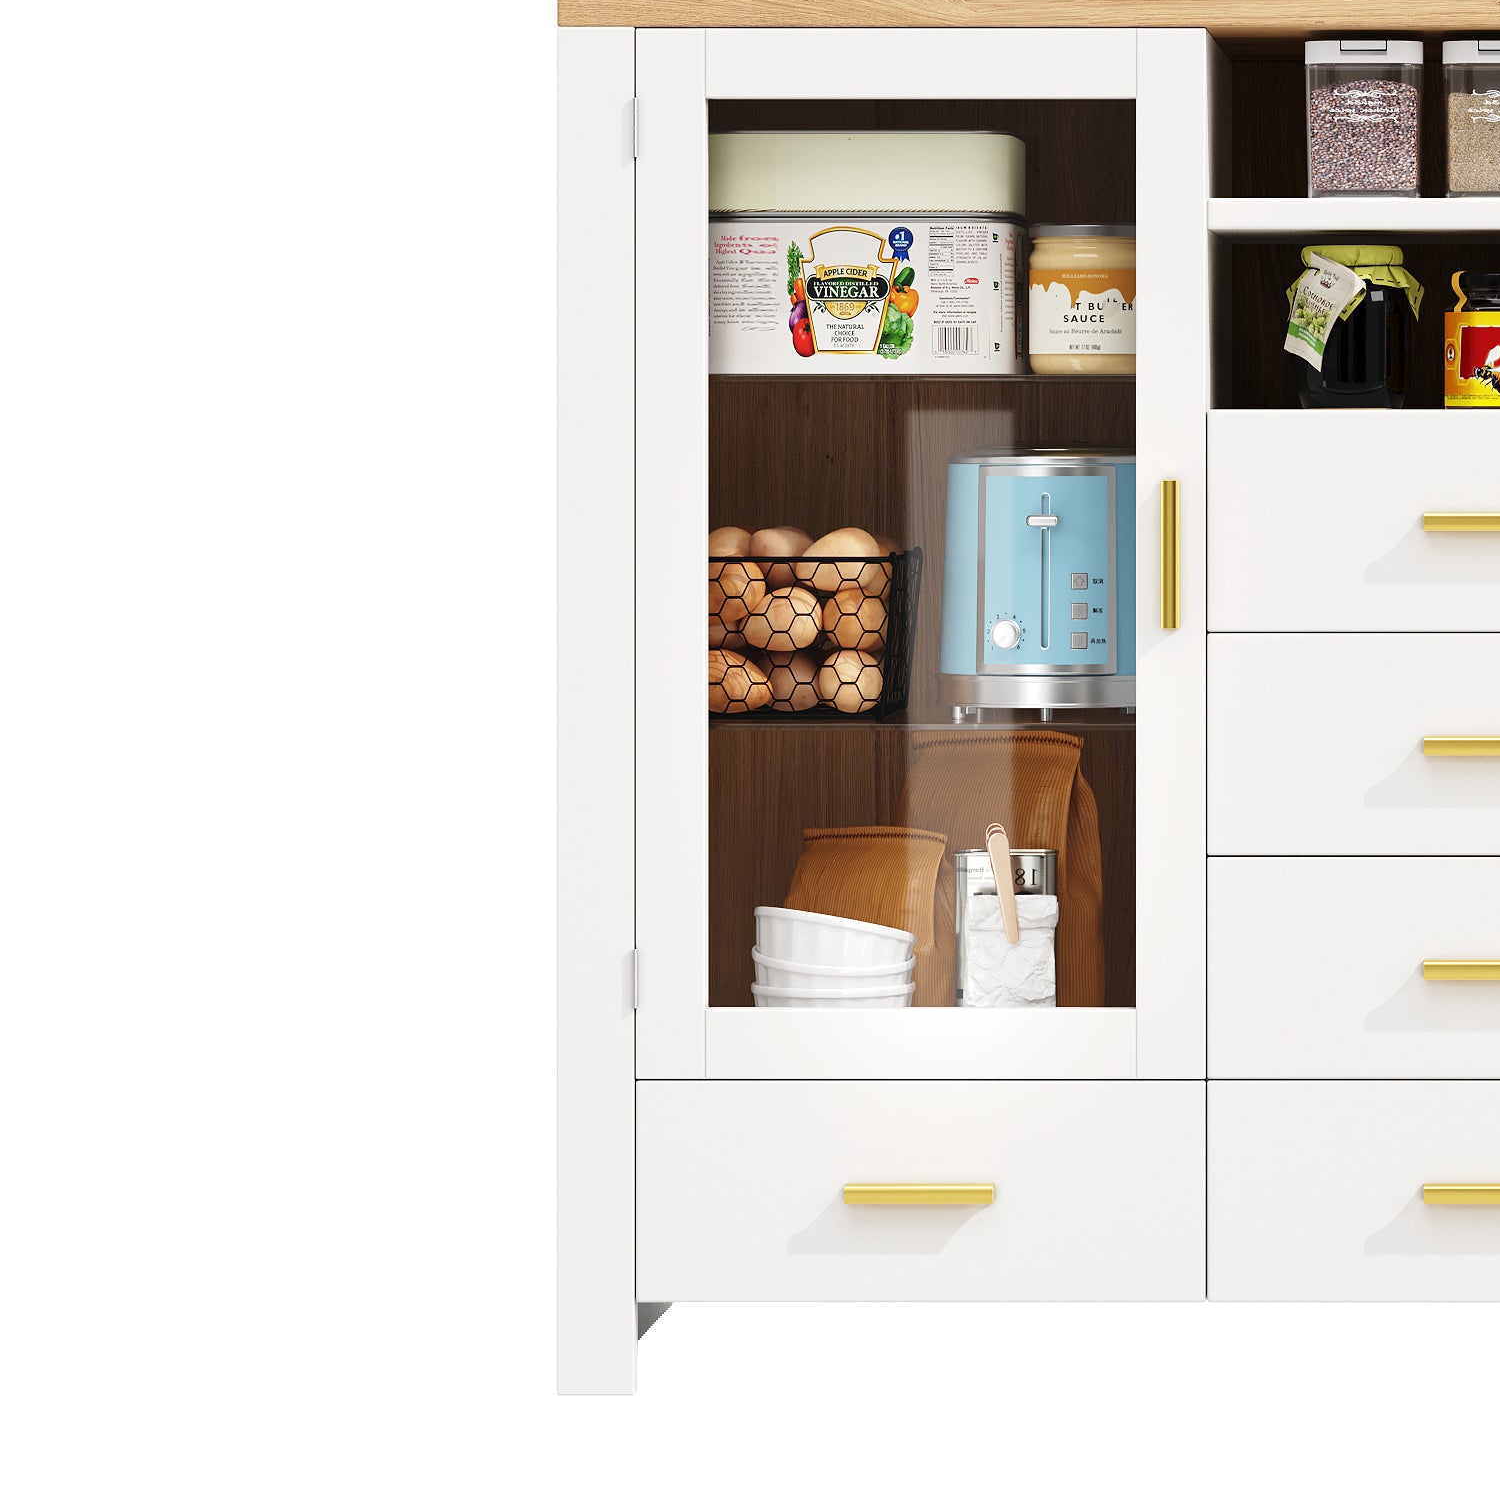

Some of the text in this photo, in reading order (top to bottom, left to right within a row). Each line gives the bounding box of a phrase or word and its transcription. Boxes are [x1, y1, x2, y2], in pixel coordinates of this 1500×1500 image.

[823, 268, 868, 277] APPLE CIDER
[813, 286, 880, 298] VINEGAR
[835, 303, 855, 311] 1869
[1063, 315, 1105, 323] SAUCE
